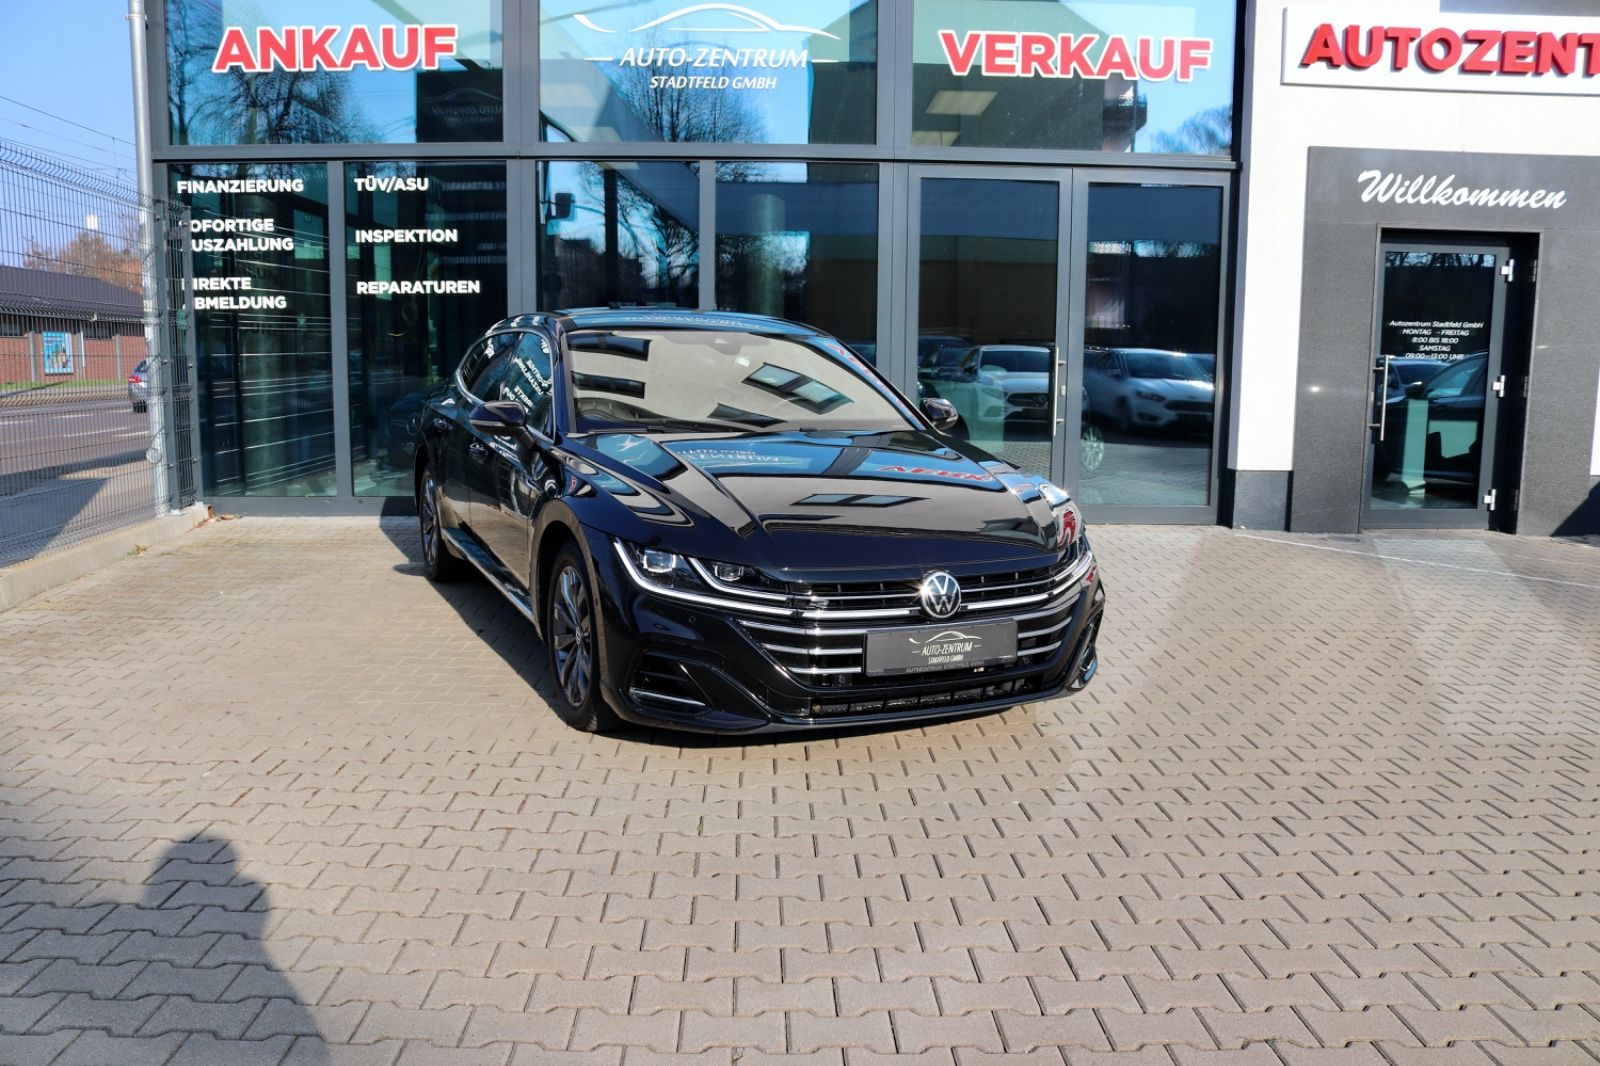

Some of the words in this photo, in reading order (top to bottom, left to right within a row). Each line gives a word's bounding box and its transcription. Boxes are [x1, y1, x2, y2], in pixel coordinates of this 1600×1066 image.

[212, 23, 458, 73] ANKAUF
[620, 47, 810, 69] AUTO-ZENTRUM
[938, 29, 1213, 83] VERKAUF
[650, 76, 729, 90] STADTFELD
[732, 76, 777, 90] GMBH
[177, 179, 305, 194] FINANZIERUNG
[353, 175, 430, 193] TÜV/ASU
[1357, 168, 1568, 210] Willkommen
[179, 218, 275, 232] OFORTIGE
[355, 229, 458, 244] INSPEKTION
[180, 237, 294, 252] USZAHLUNG
[356, 280, 481, 296] REPARATUREN
[182, 296, 287, 310] BMELDUNG
[1402, 328, 1432, 336] MONTAG
[1432, 320, 1462, 328] Stadtfeld
[1462, 321, 1484, 329] GmbH
[921, 641, 974, 657] AUTO-ZENTRUM
